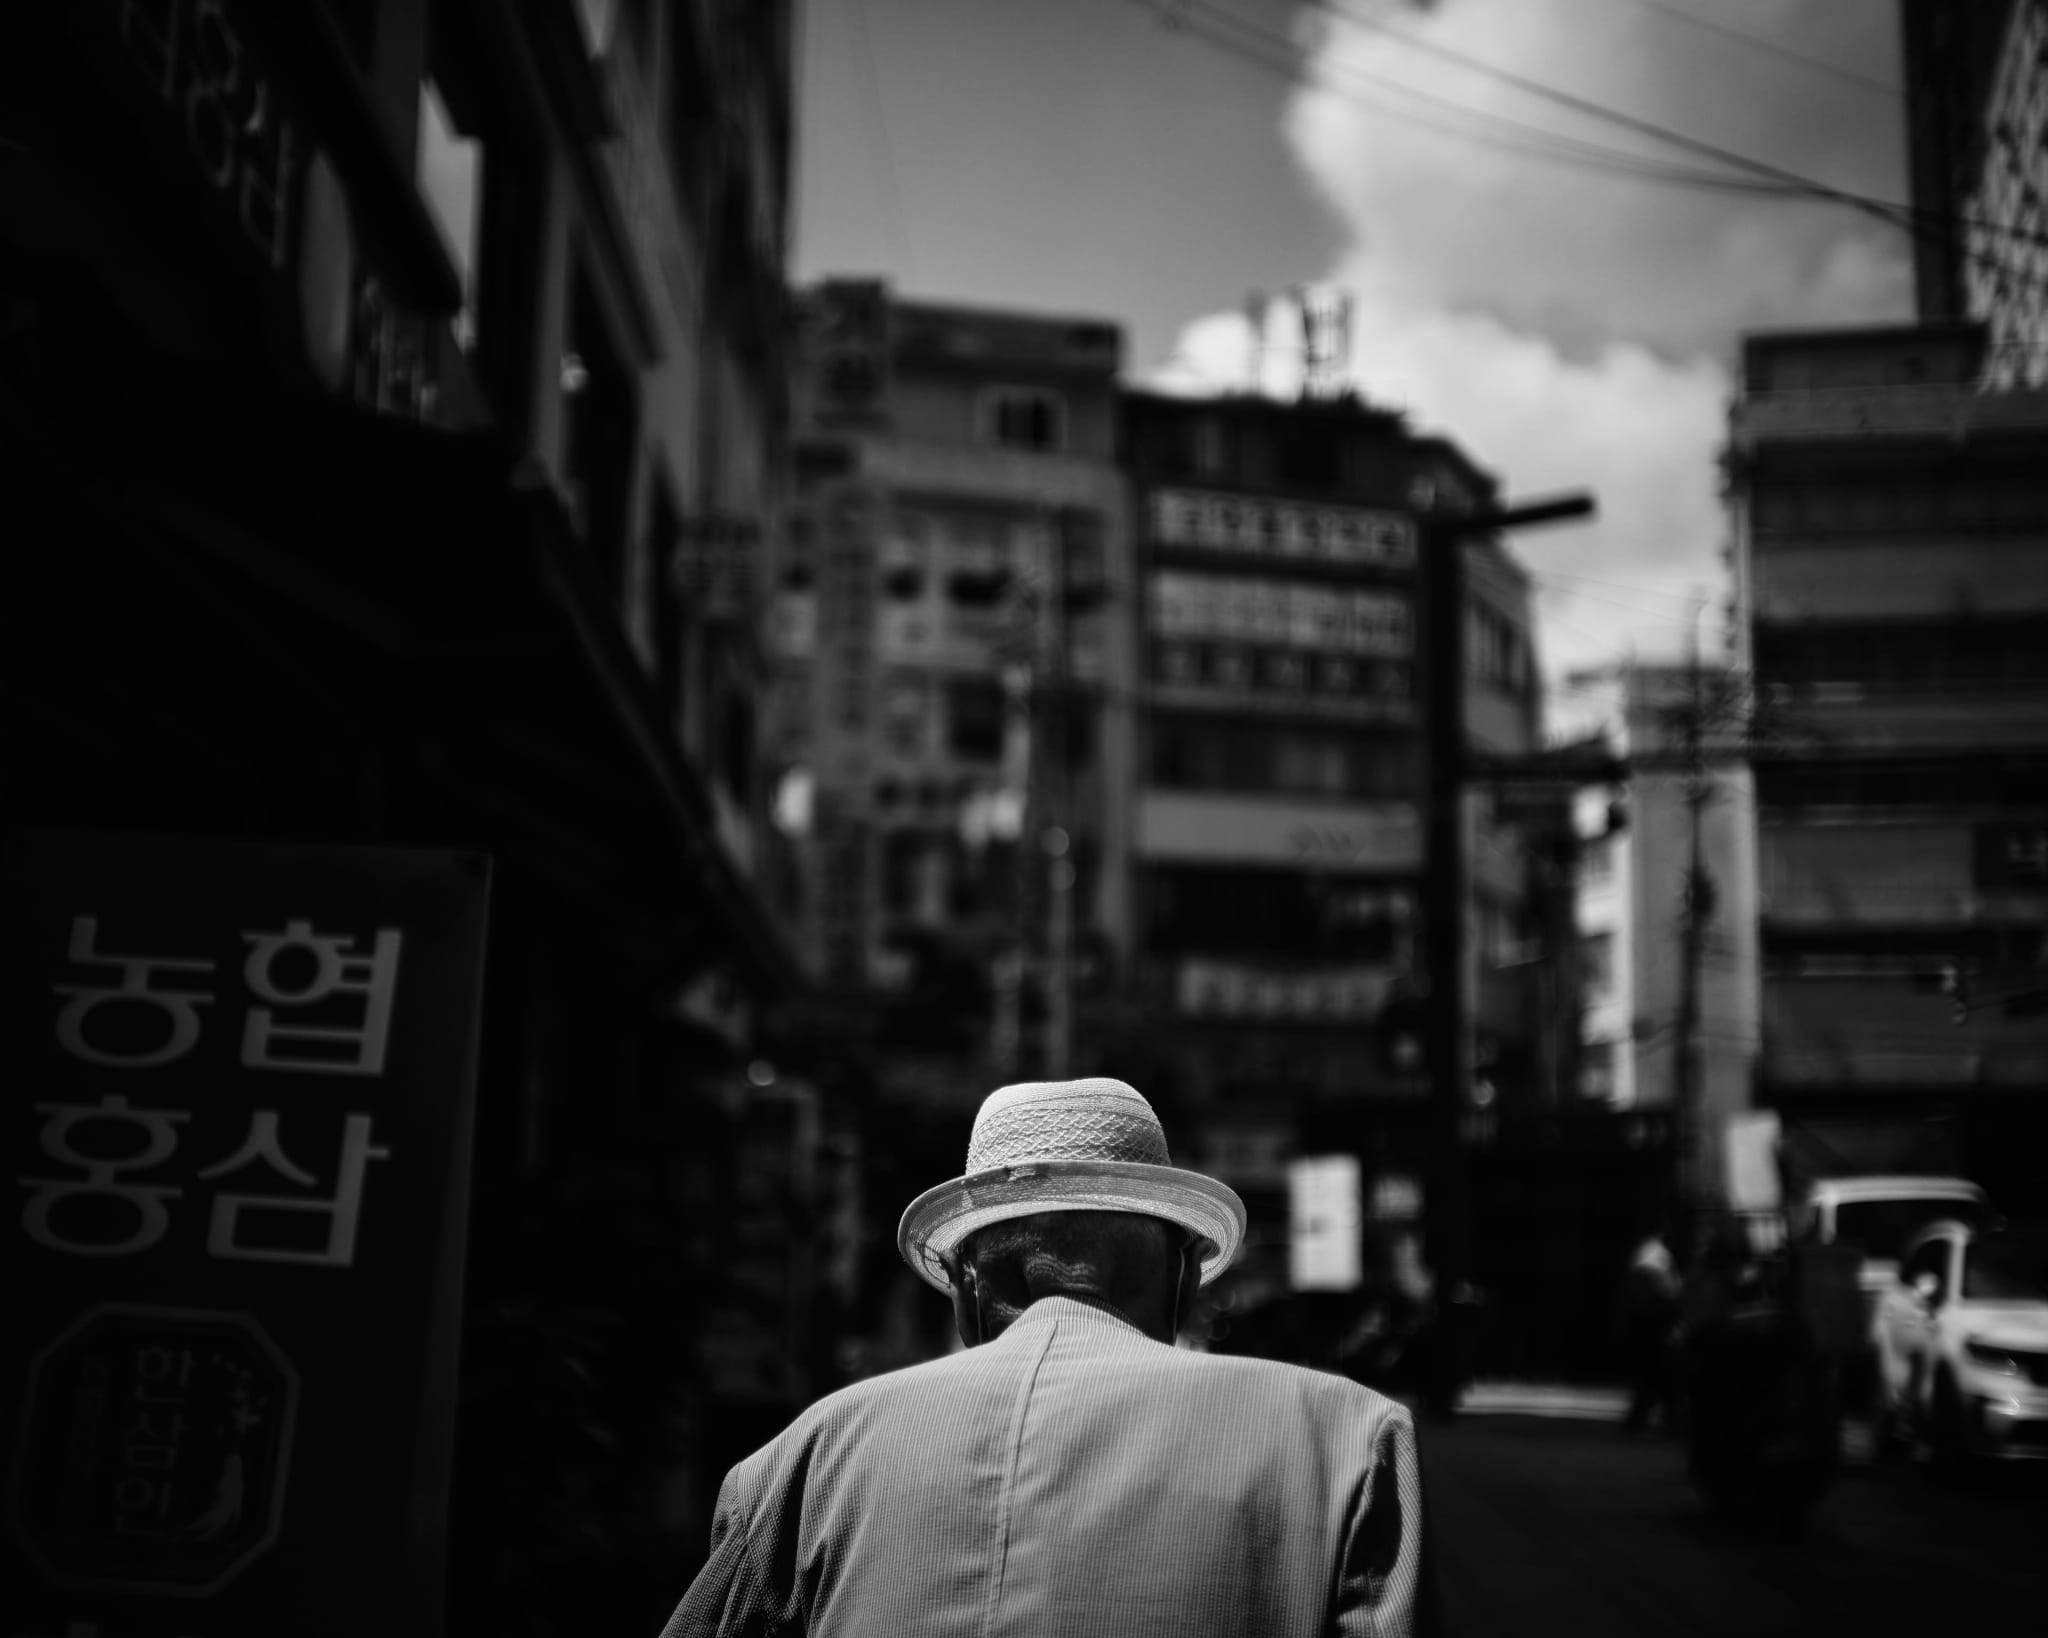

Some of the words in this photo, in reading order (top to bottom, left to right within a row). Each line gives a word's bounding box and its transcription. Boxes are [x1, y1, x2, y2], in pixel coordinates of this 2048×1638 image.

[52, 914, 404, 1078] 농협
[16, 1094, 391, 1269] 홍삼
[113, 1346, 198, 1536] 한삼인
